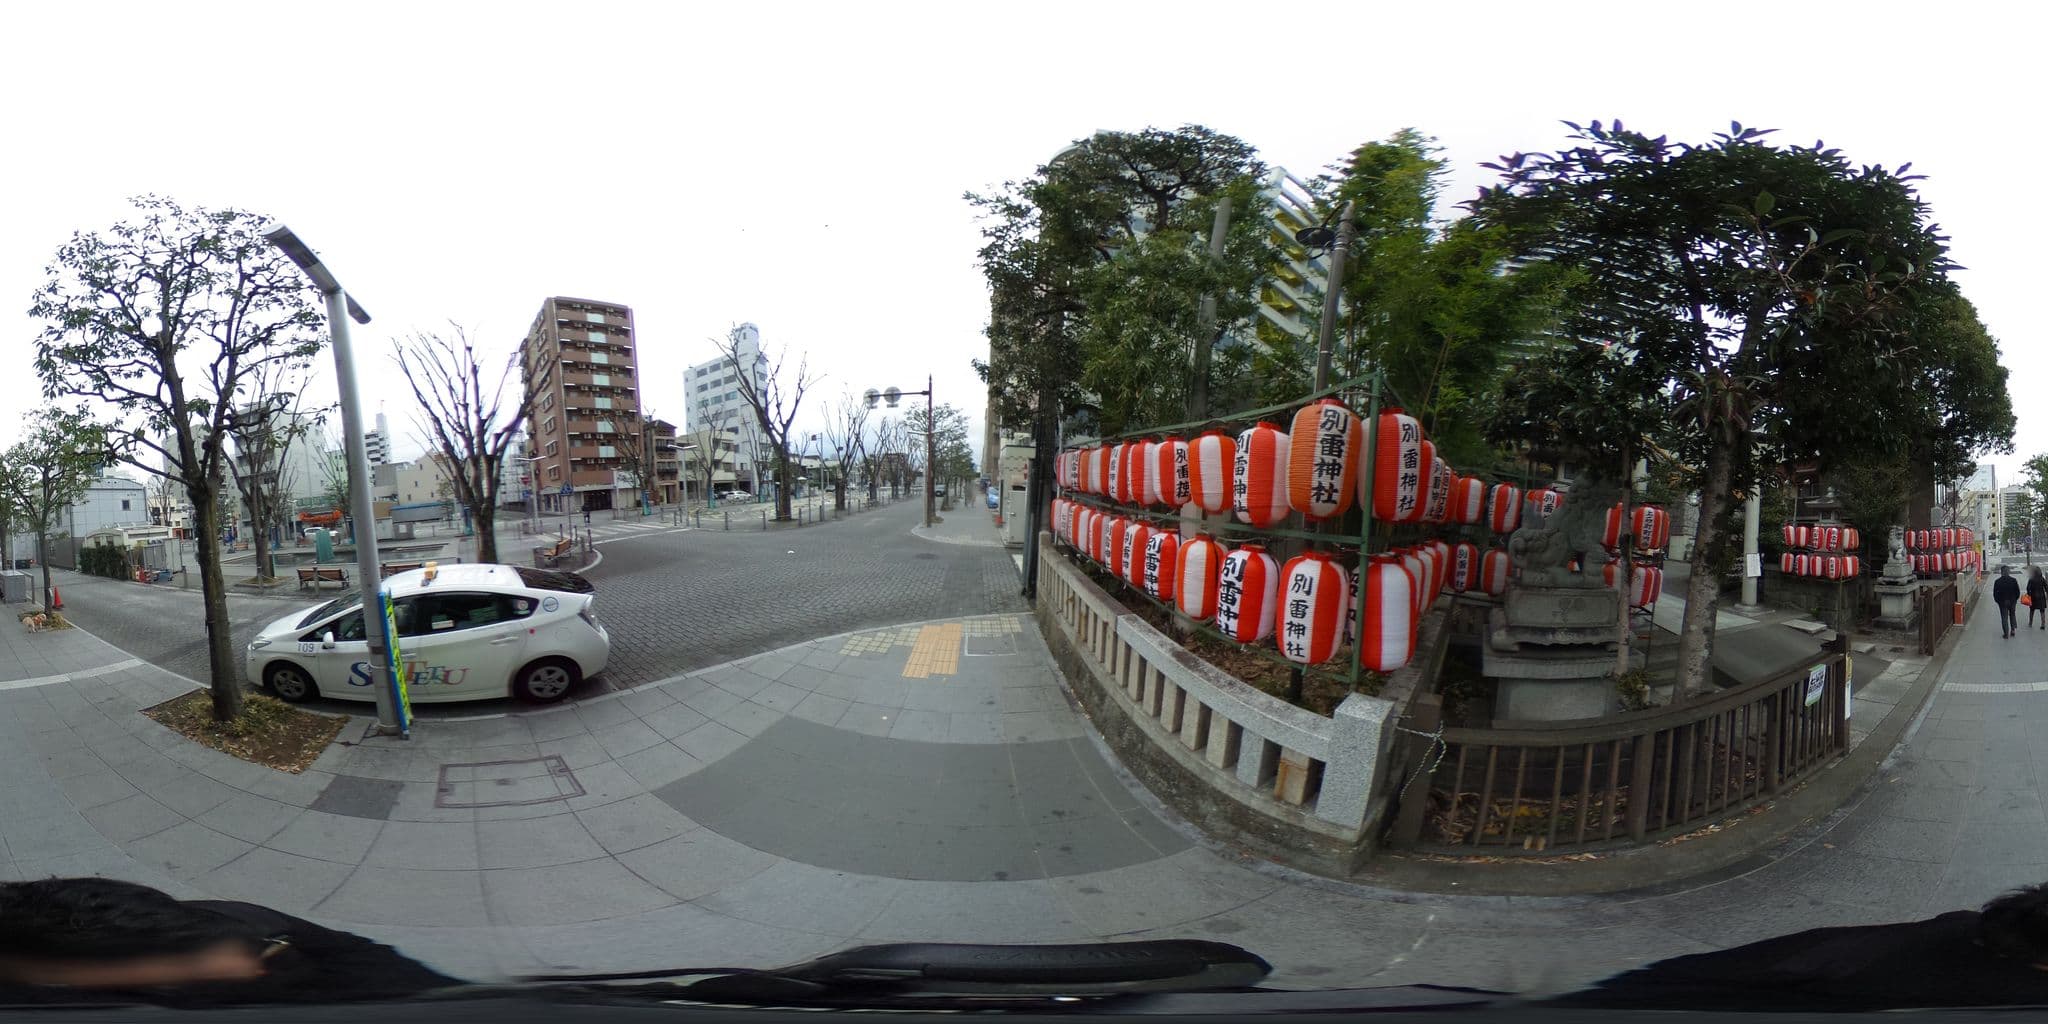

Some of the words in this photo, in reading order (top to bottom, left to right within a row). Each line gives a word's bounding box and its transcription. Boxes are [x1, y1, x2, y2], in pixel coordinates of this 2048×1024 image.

[1311, 408, 1349, 505] 別雷神社
[1398, 423, 1419, 513] 別雷神社
[1218, 556, 1248, 638] 別雷神社
[1285, 573, 1314, 658] 別雷神社
[298, 643, 315, 653] 109
